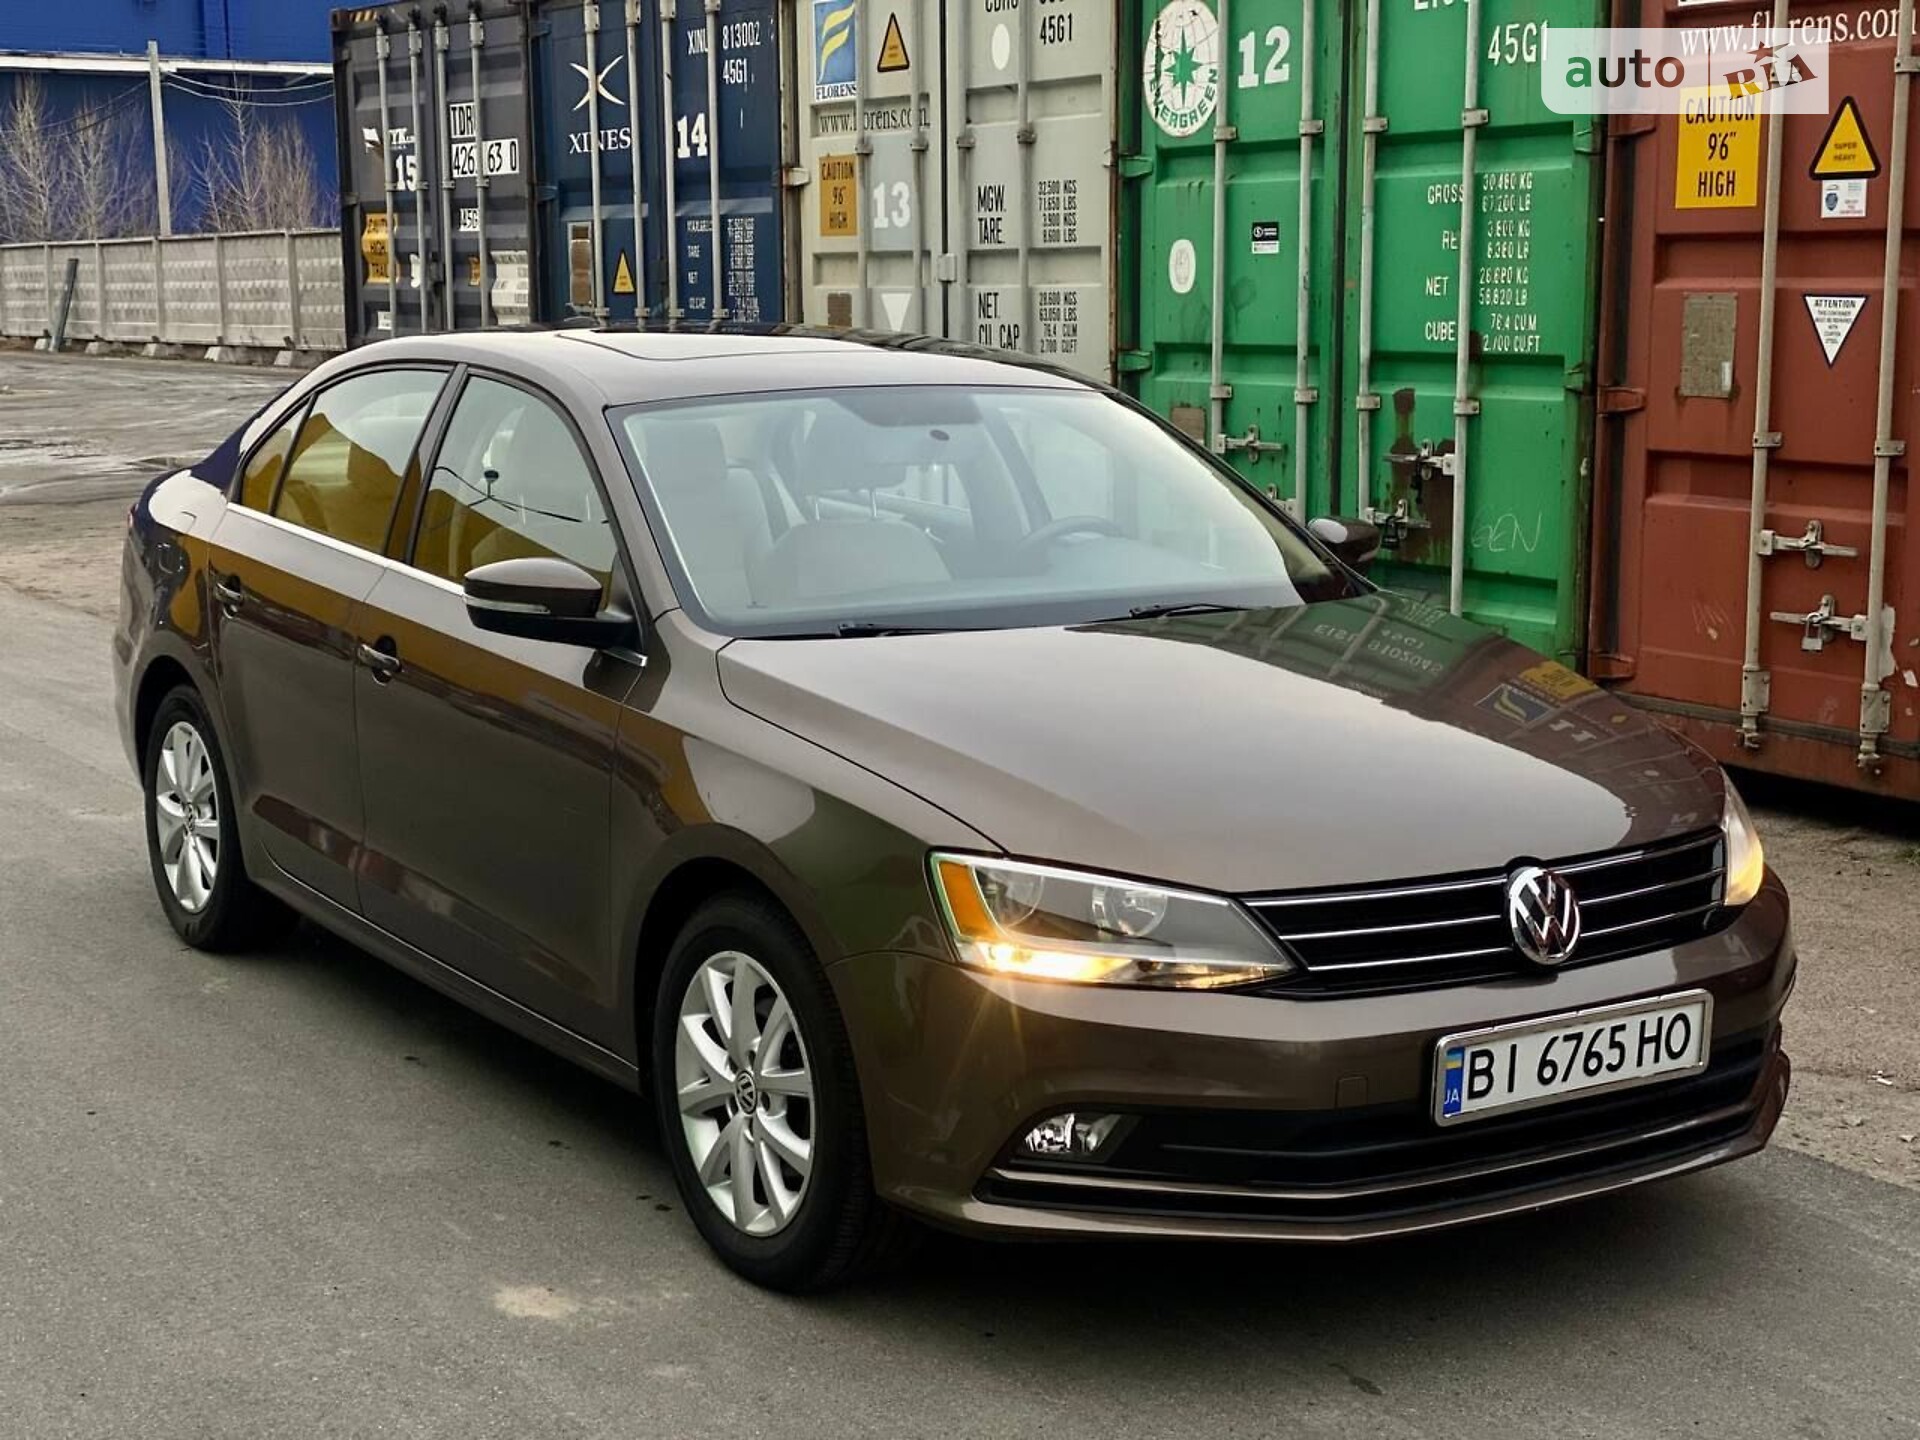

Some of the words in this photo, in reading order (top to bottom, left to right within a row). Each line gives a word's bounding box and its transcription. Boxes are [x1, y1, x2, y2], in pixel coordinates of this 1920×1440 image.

[722, 21, 761, 50] 813002
[1040, 12, 1073, 45] 45G1
[1487, 19, 1548, 66] 45G1
[722, 58, 748, 85] 45G1
[1238, 25, 1290, 89] 12
[816, 83, 857, 99] FLORENS
[451, 105, 477, 137] TDR
[1685, 95, 1755, 125] CAUTION
[569, 127, 631, 154] XINES
[677, 112, 708, 159] 14
[396, 154, 418, 192] 15
[1697, 171, 1736, 198] HIGH
[873, 181, 911, 228] 13
[1425, 275, 1449, 297] NET
[1814, 299, 1856, 309] ATTENTION
[1424, 320, 1456, 342] CUBE
[1536, 1023, 1627, 1086] 6765
[1635, 1012, 1692, 1068] HO
